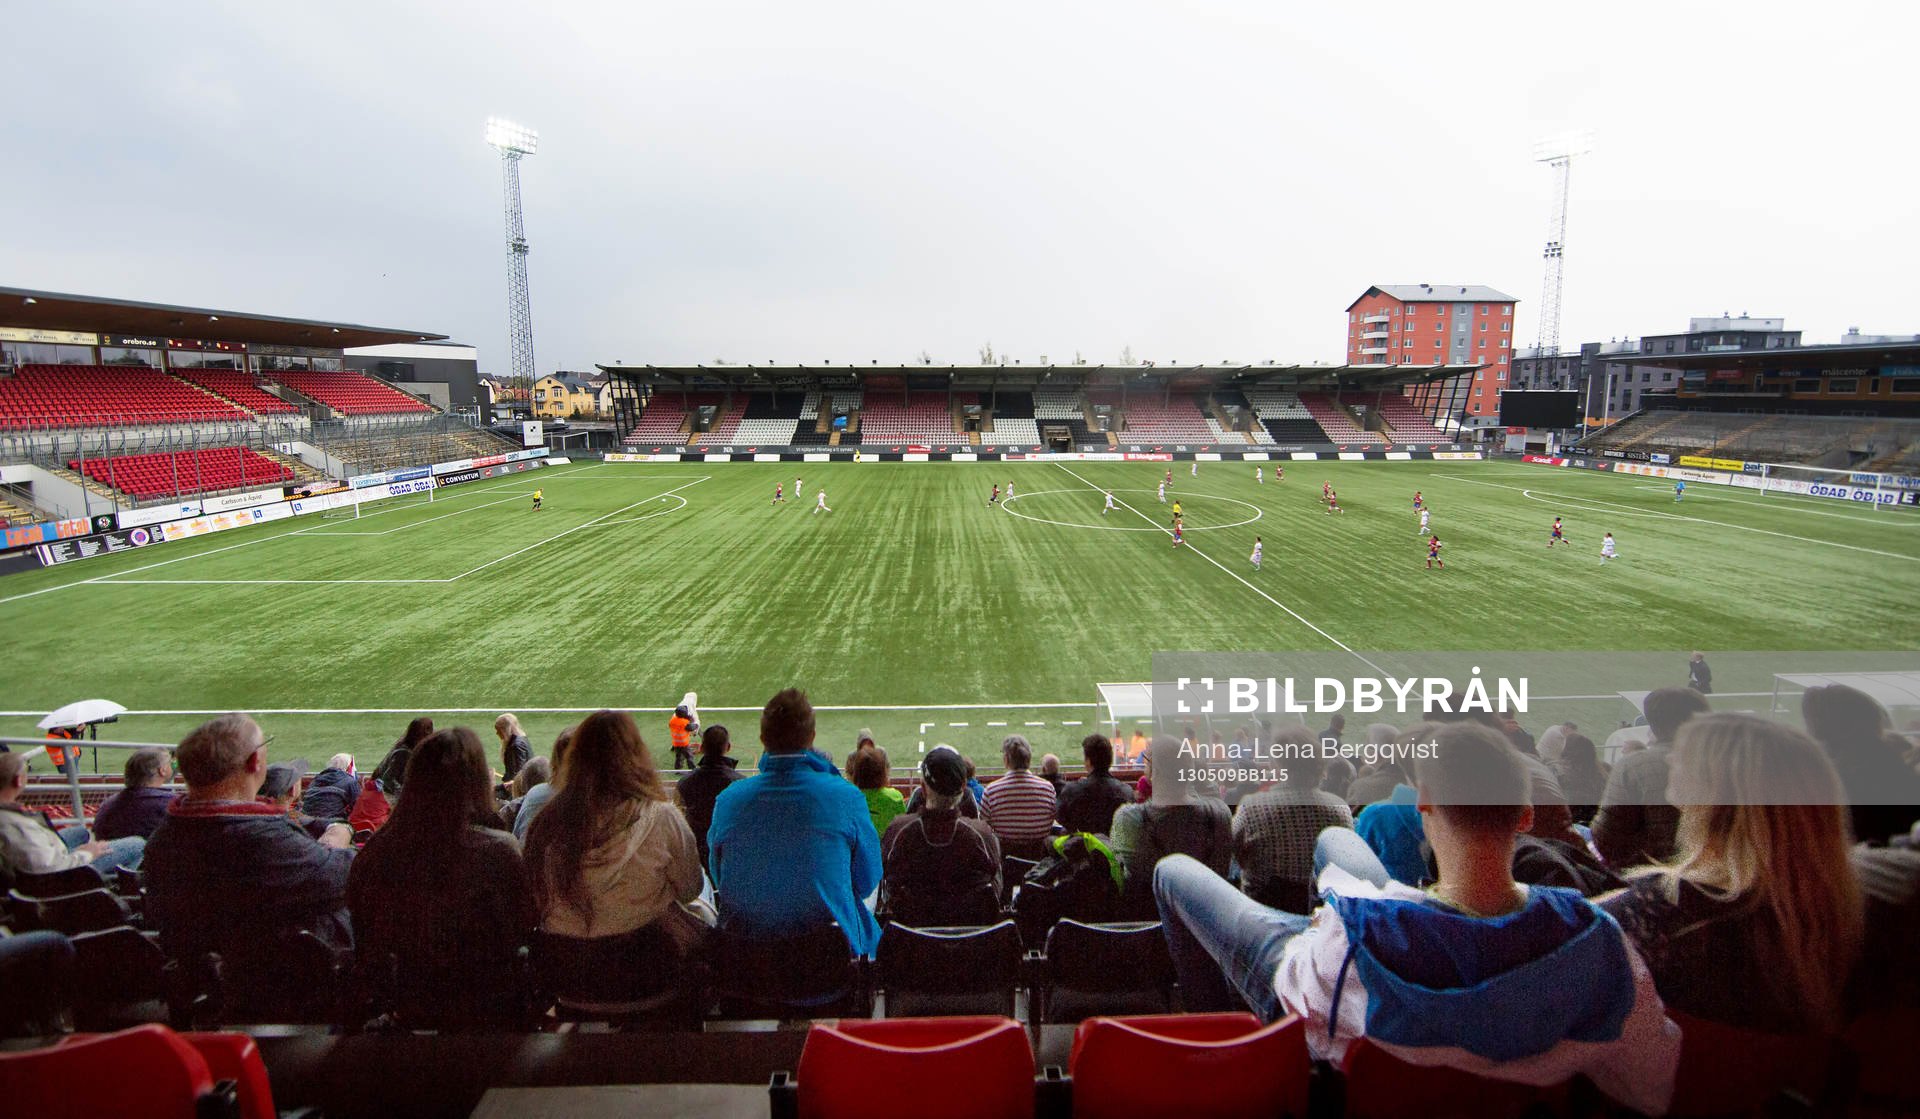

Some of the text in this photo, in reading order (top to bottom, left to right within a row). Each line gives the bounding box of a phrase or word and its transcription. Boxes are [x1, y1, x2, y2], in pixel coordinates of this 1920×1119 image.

[445, 472, 479, 484] CONVENTUM
[1810, 481, 1847, 498] ÖBAB
[56, 517, 91, 539] tetab
